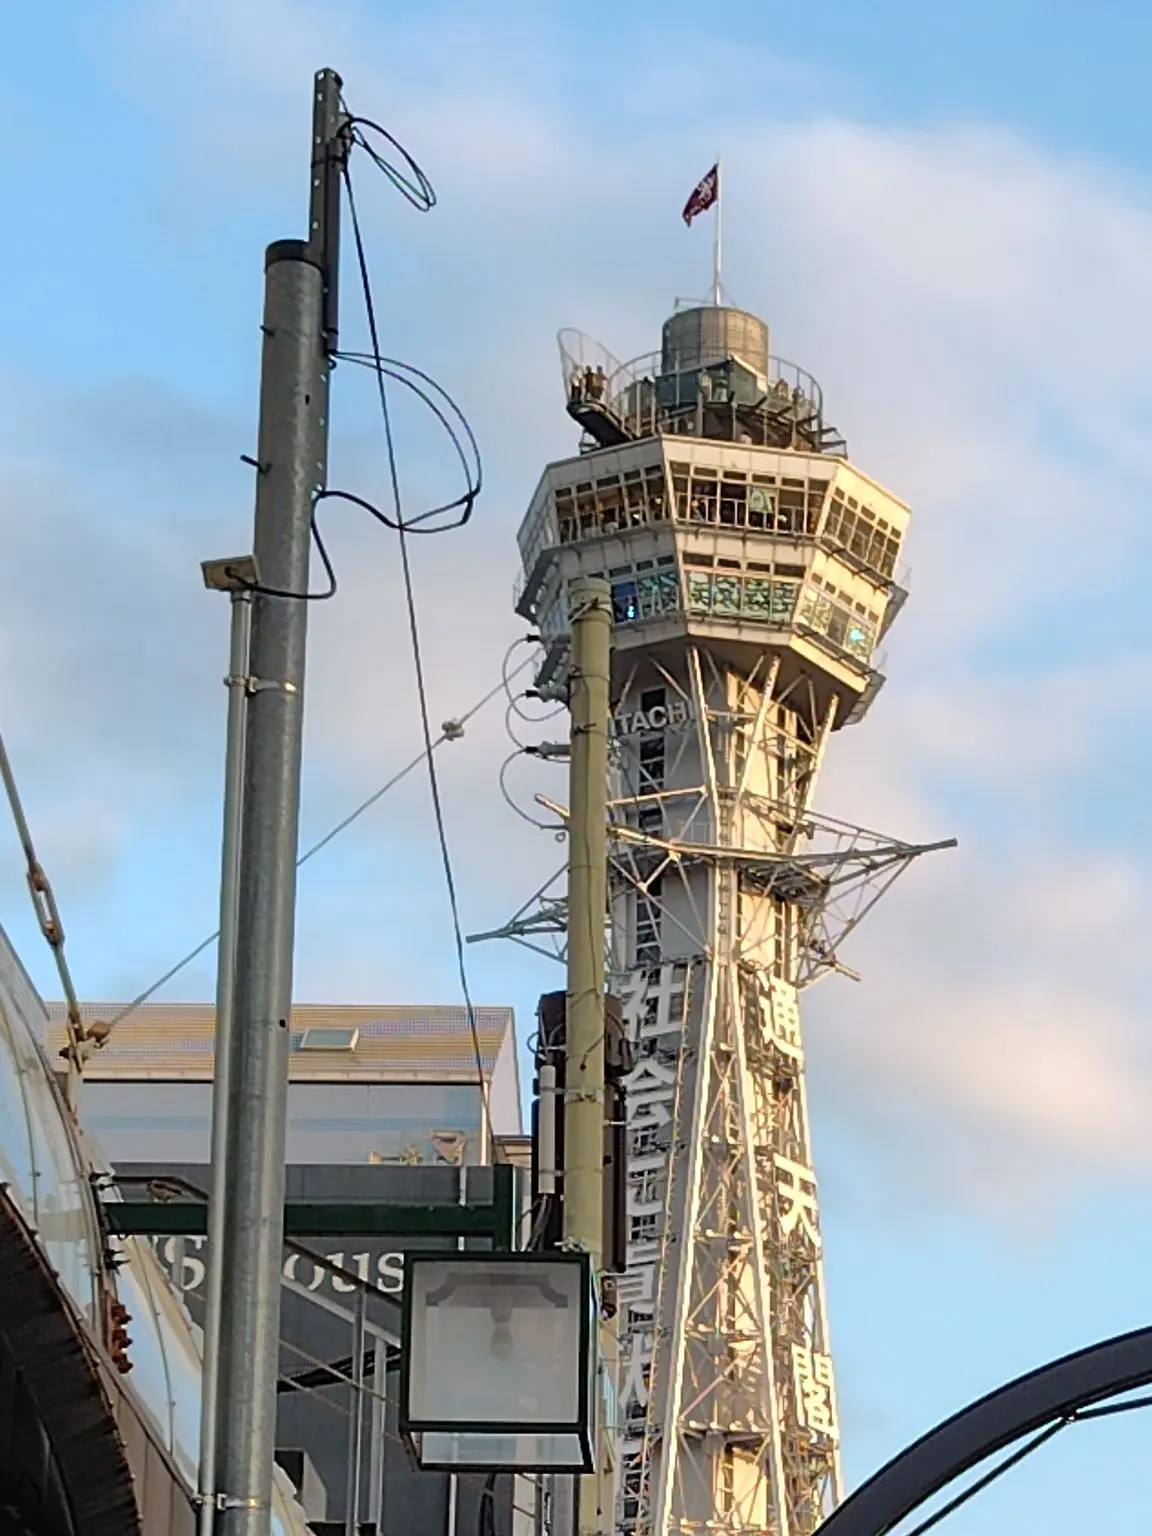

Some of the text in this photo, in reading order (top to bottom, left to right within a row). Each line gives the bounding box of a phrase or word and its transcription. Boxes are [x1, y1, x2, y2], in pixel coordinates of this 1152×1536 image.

[608, 701, 688, 738] ITACH
[757, 972, 840, 1441] 通天閣
[283, 1252, 405, 1294] ous
